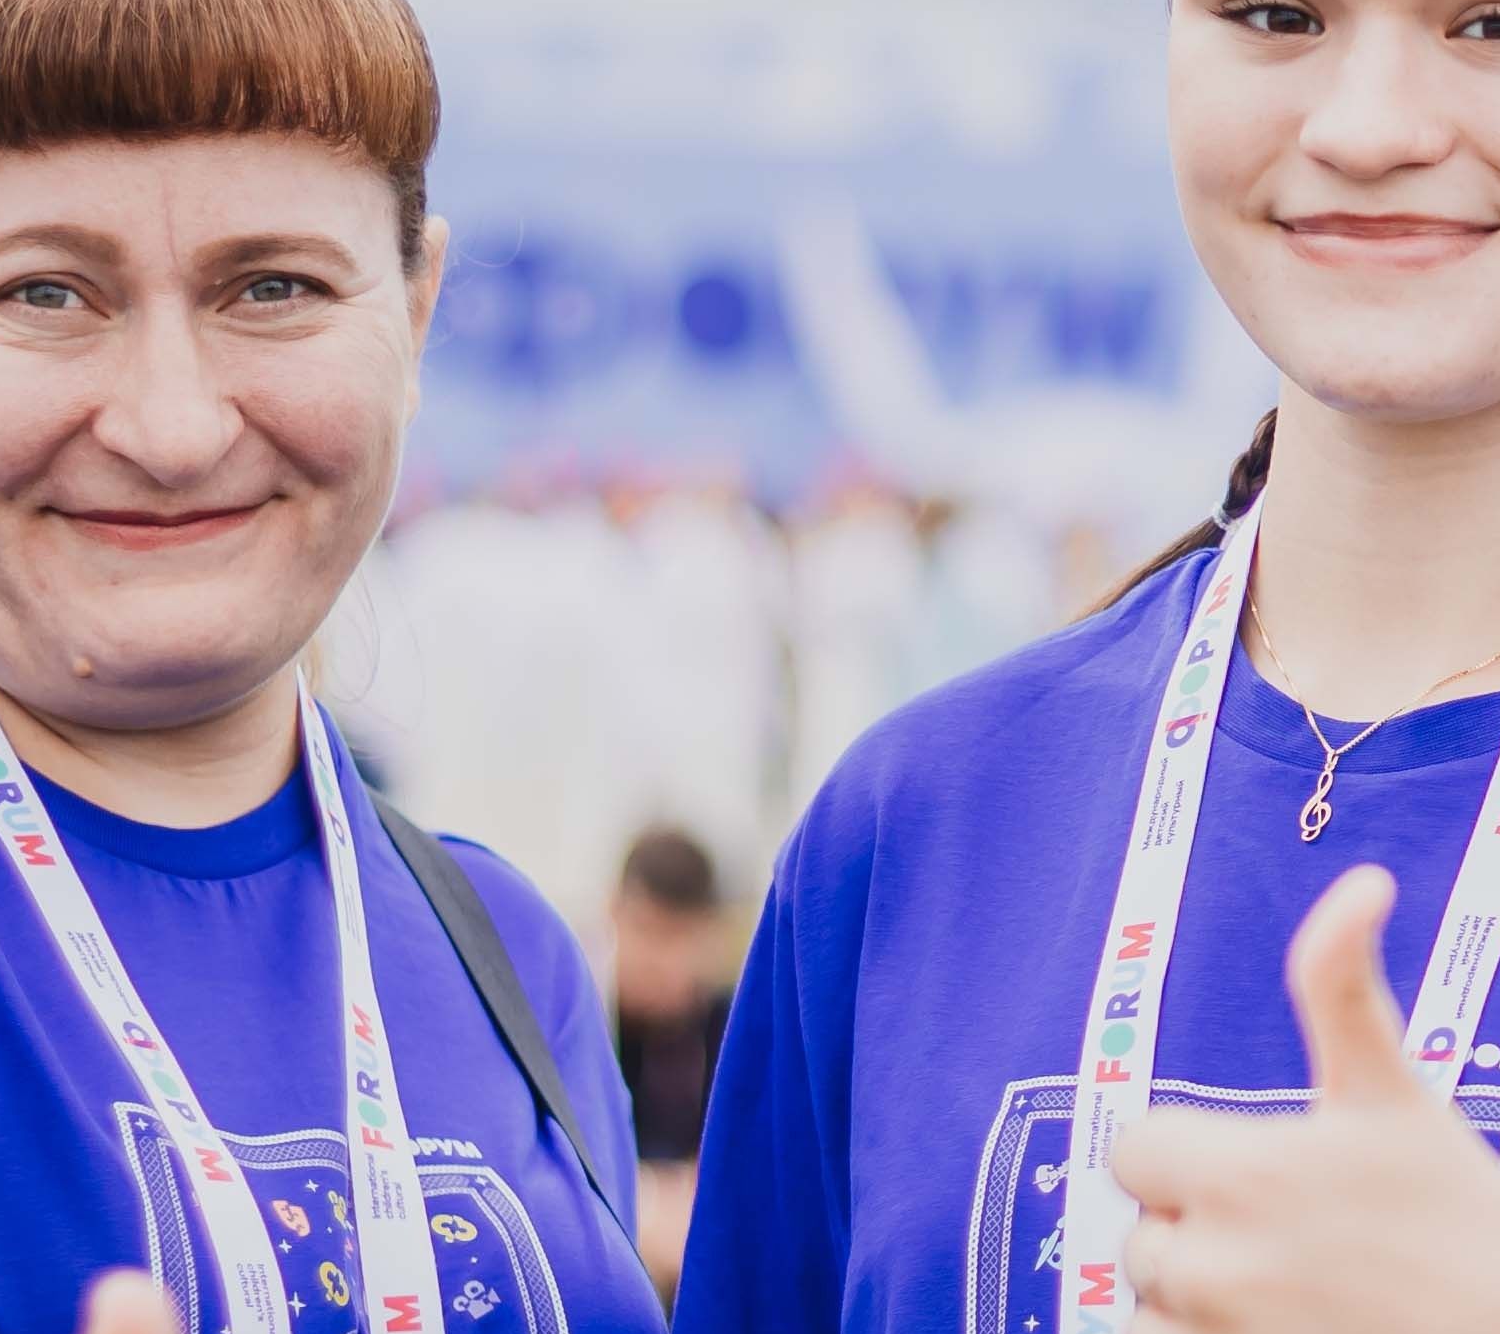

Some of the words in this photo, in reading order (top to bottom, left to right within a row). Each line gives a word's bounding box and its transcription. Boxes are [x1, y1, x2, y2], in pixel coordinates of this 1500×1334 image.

[1166, 574, 1233, 748] ФОРУМ
[1142, 757, 1168, 850] Международный
[1155, 801, 1169, 846] детский
[1166, 779, 1184, 845] культурный
[1443, 915, 1470, 986] культурный
[1455, 916, 1497, 1019] Международный
[1462, 916, 1482, 965] детский
[1096, 922, 1156, 1083] FORUM
[123, 1021, 234, 1182] ФОРУМ
[352, 1003, 394, 1150] FORUM
[1086, 1091, 1103, 1169] International
[237, 1263, 253, 1307] cultural
[248, 1263, 264, 1321] children's
